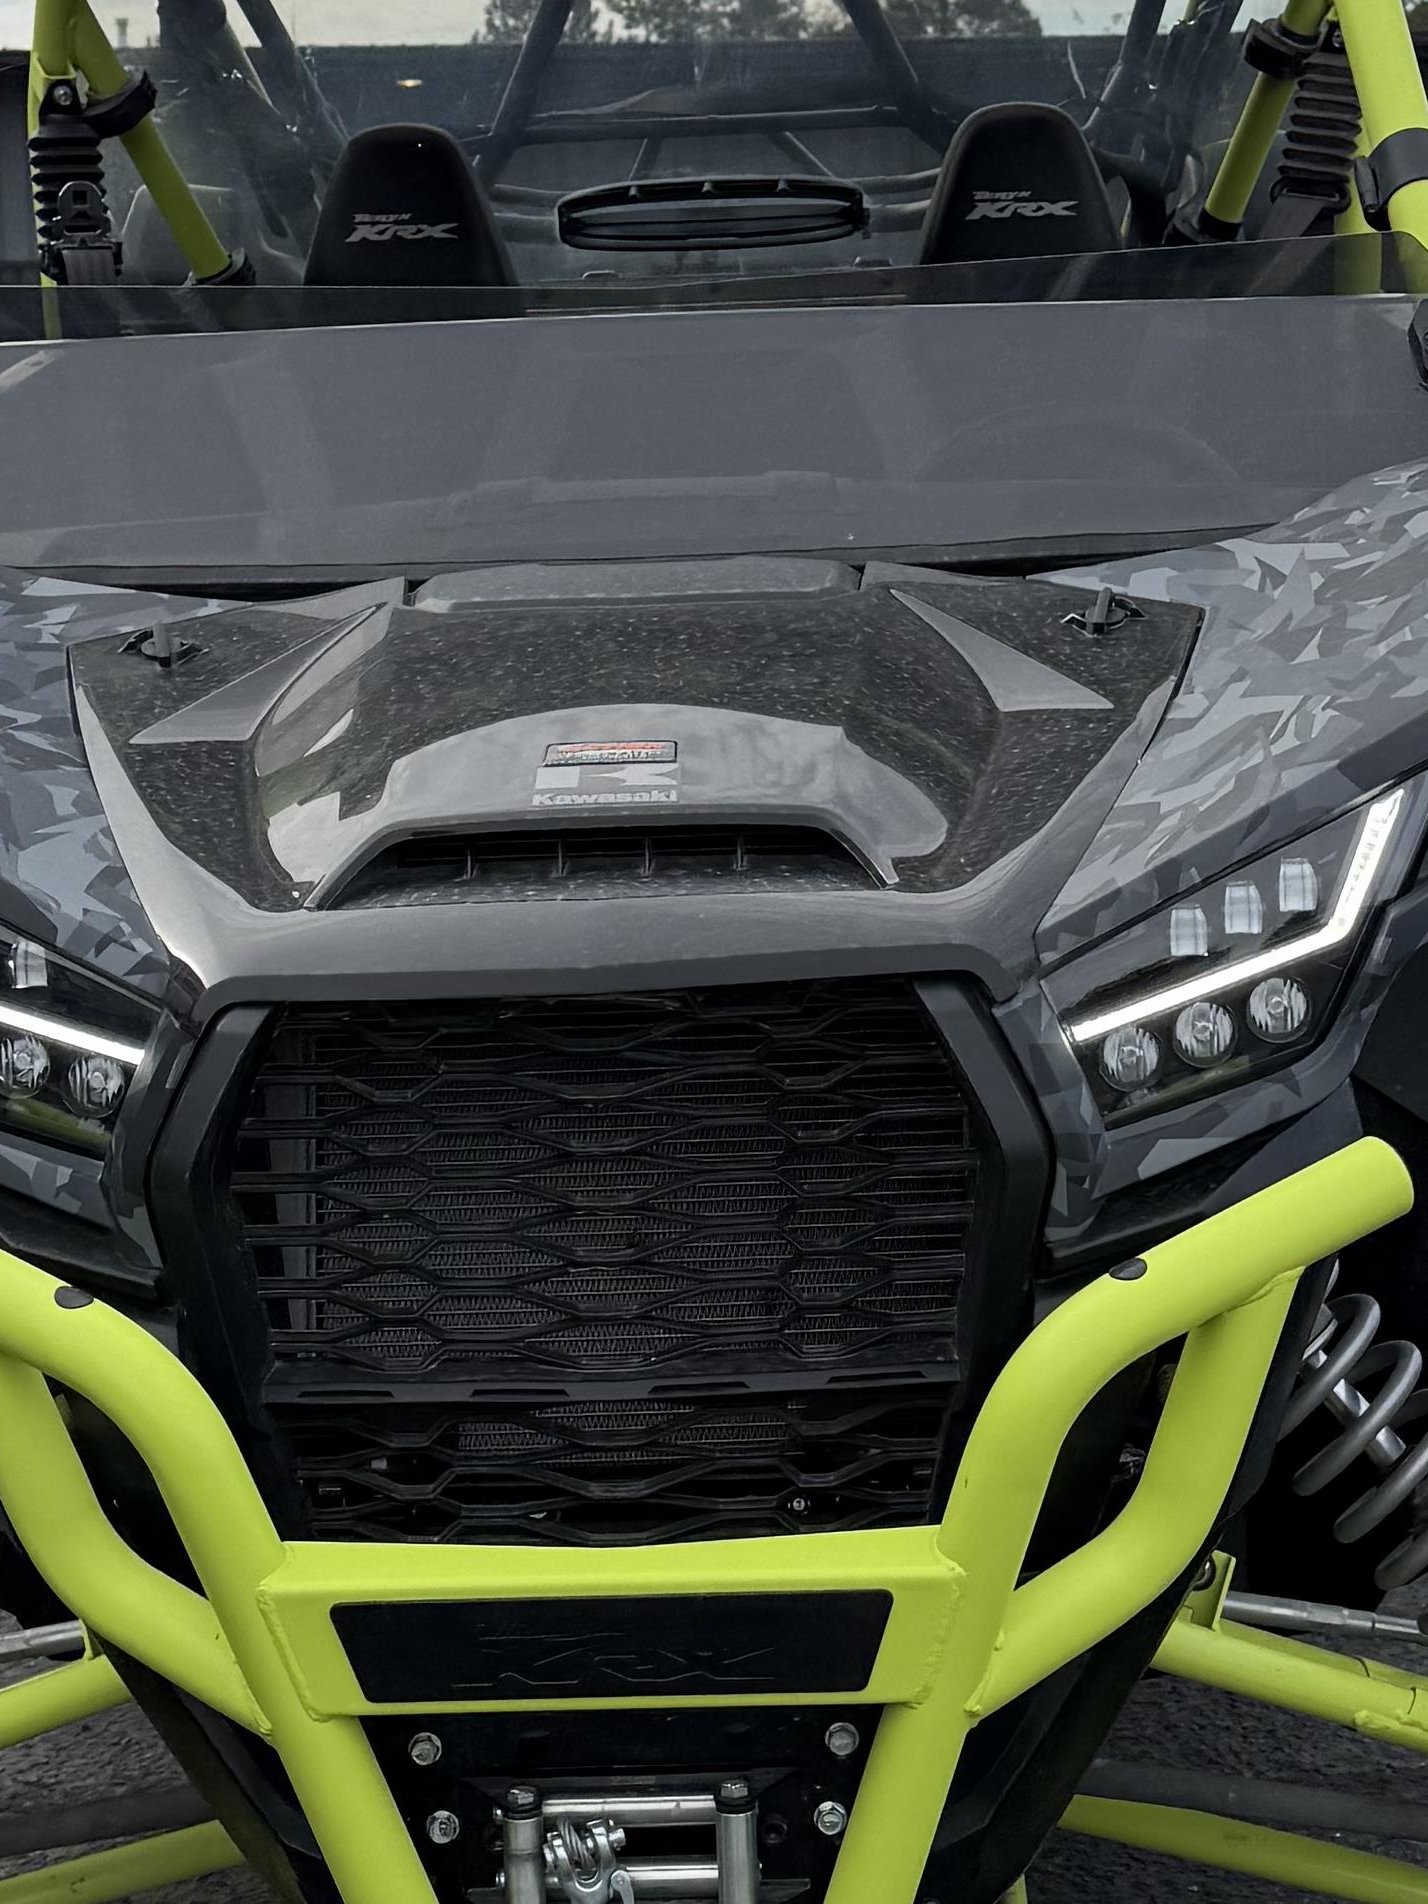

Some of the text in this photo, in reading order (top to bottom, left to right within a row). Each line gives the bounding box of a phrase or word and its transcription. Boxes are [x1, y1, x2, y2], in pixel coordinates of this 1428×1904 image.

[964, 200, 1079, 221] KRX
[345, 222, 460, 243] KRX
[532, 789, 678, 807] Kawasaki
